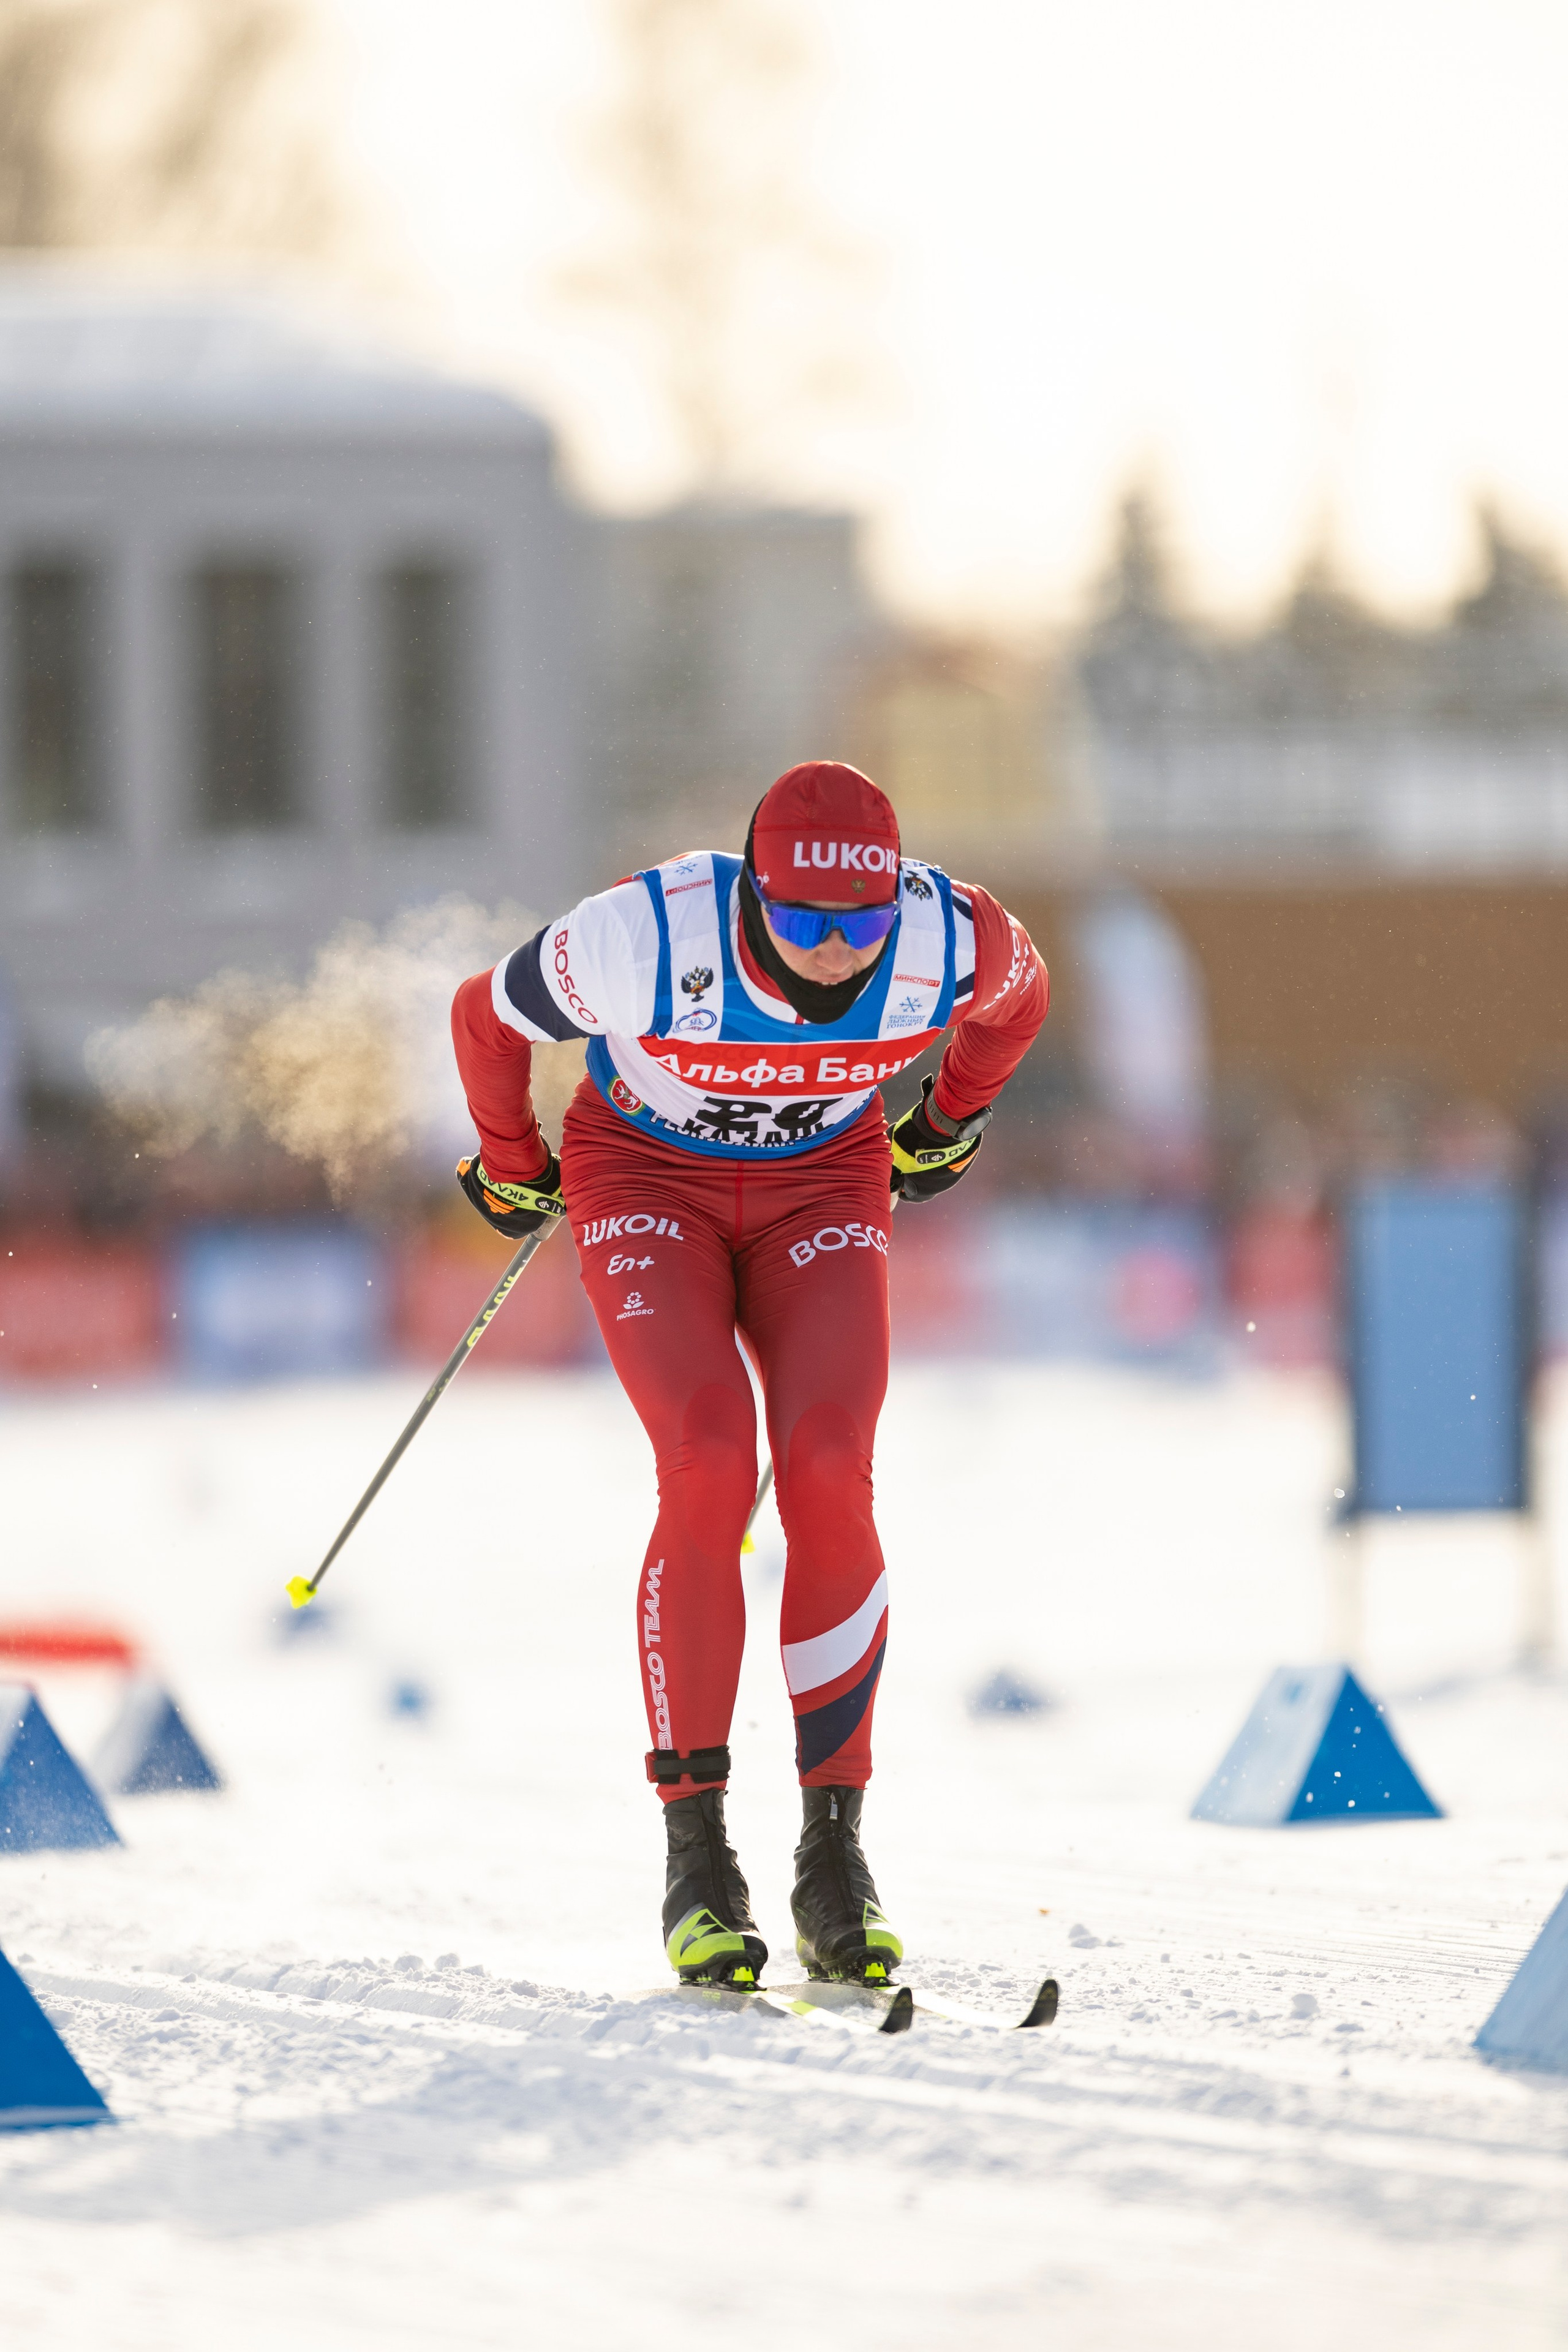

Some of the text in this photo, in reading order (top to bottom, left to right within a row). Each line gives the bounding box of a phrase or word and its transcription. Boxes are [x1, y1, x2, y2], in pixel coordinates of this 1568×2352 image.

[793, 842, 897, 874] LUKOIL
[554, 929, 598, 1023] BOSCO
[893, 974, 940, 987] МИНСПОРТ
[655, 1054, 805, 1088] Альфа
[582, 1214, 684, 1246] LUKOIL
[607, 1254, 655, 1275] En+
[616, 1308, 654, 1327] PHOSAGRO
[644, 1559, 673, 1751] BOSCO TEAM
